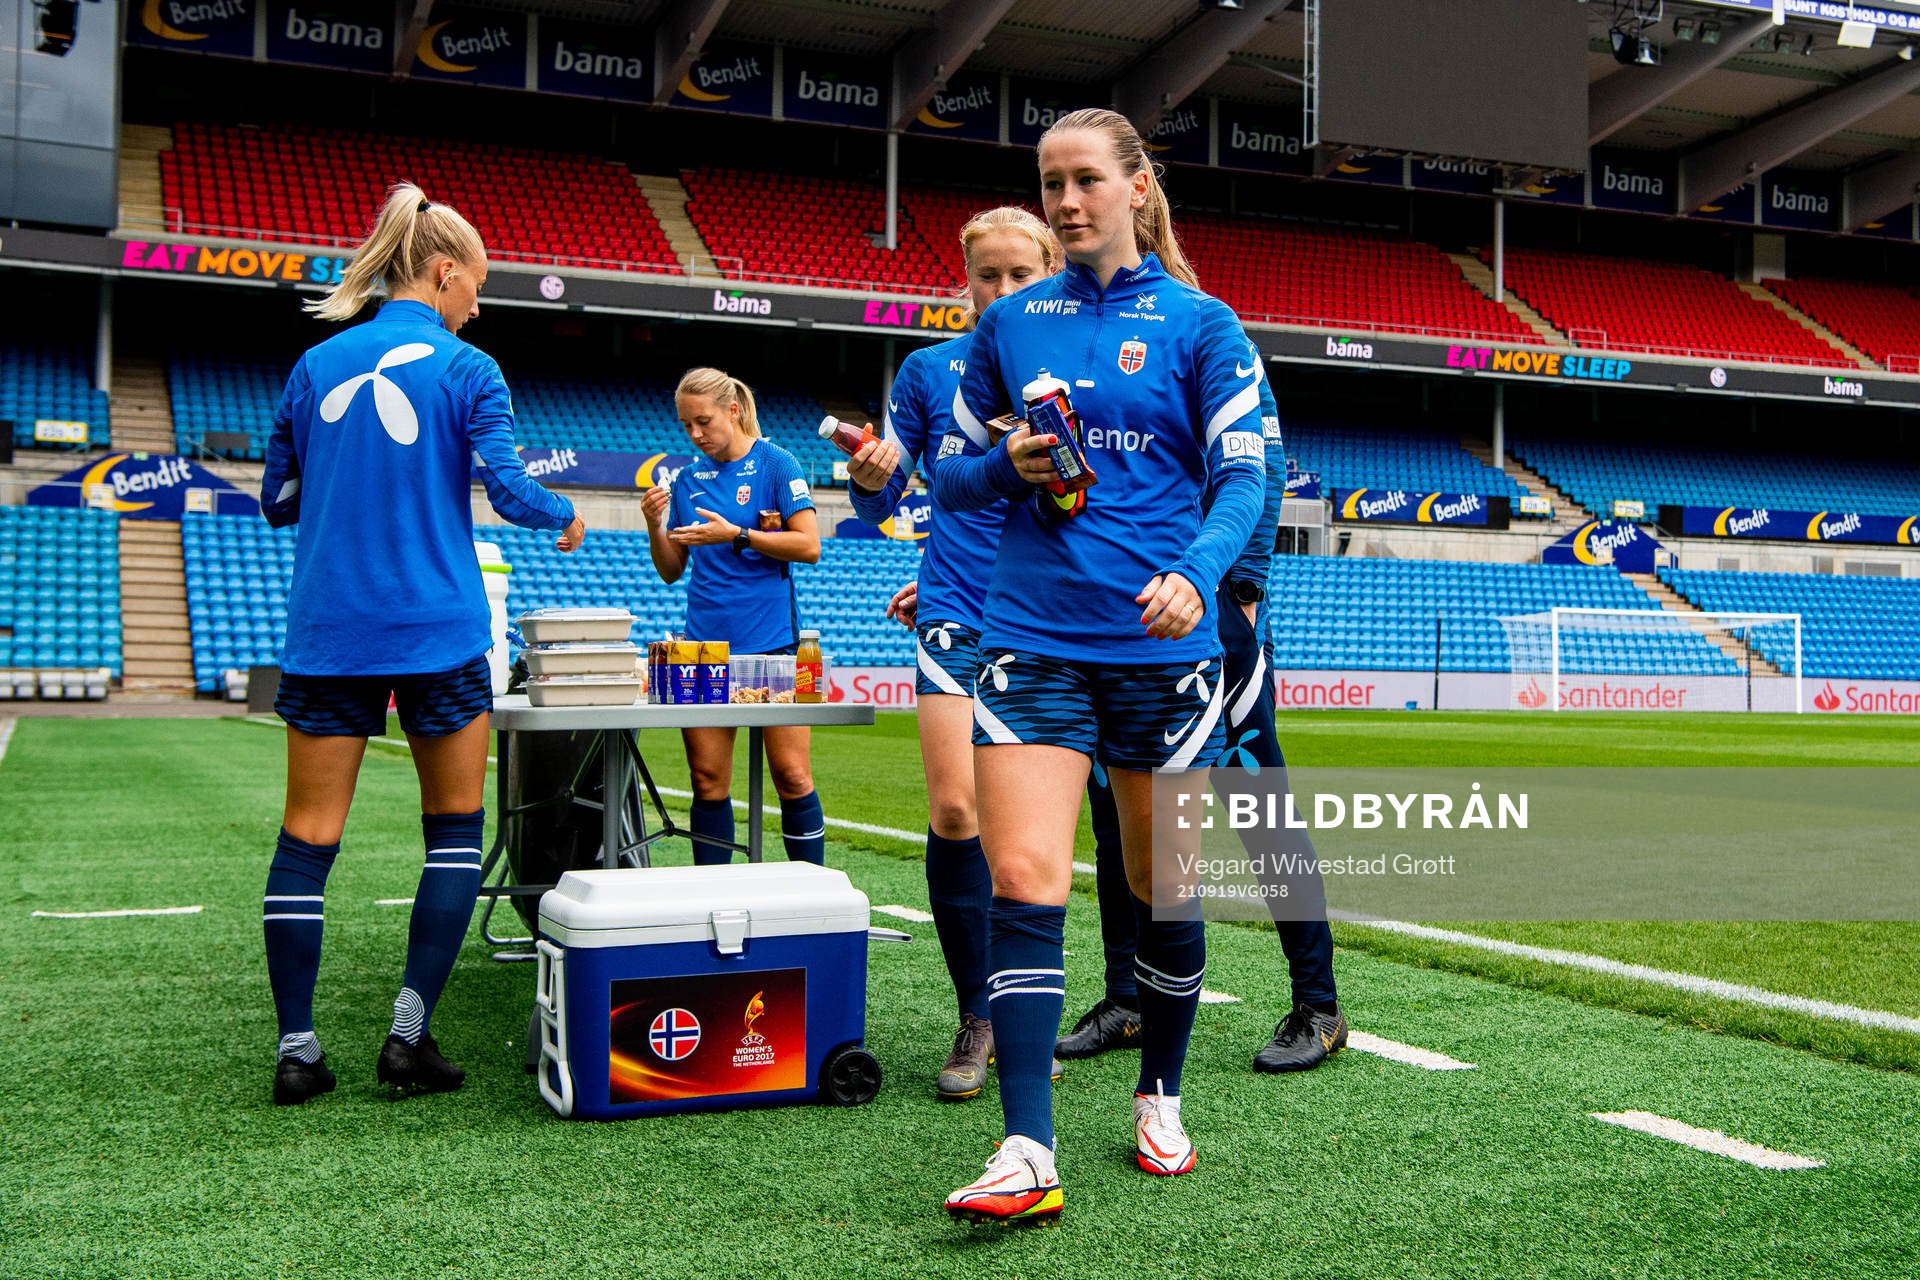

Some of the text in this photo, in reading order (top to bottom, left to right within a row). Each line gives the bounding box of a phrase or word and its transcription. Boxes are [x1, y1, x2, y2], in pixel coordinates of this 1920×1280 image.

[170, 0, 247, 24] Bendit
[1888, 13, 1907, 27] OG
[286, 9, 383, 48] bama
[441, 27, 511, 57] Bendit
[554, 41, 643, 79] bama
[698, 57, 762, 87] Bendit
[798, 70, 879, 107] bama
[934, 85, 993, 115] Bendit
[1230, 122, 1300, 156] bama
[1603, 165, 1663, 196] bama
[1771, 184, 1829, 213] bama
[122, 241, 196, 271] EAT
[197, 246, 305, 280] MOVE
[713, 290, 771, 315] bama
[863, 300, 968, 330] EAT MO
[1024, 298, 1082, 315] KIWI mini
[1062, 305, 1078, 316] pris
[1119, 311, 1166, 322] Norsk Tipping
[1326, 337, 1373, 359] bama
[1446, 345, 1631, 381] EAT MOVE SLEEP
[1824, 376, 1863, 396] bama
[1262, 416, 1279, 436] NB
[112, 456, 193, 496] Bendit
[526, 448, 578, 477] endit
[1360, 489, 1407, 518] Bendit
[1434, 494, 1480, 522] Bendit
[1729, 508, 1770, 535] Bendit
[1821, 512, 1861, 539] Bendit
[1591, 523, 1638, 552] Bendit
[679, 665, 697, 678] YT
[708, 665, 726, 678] YT
[1559, 681, 1687, 710] Santander
[735, 1045, 773, 1055] WOMEN'S
[742, 1034, 764, 1045] UEFA
[732, 1052, 775, 1063] EURO 2017
